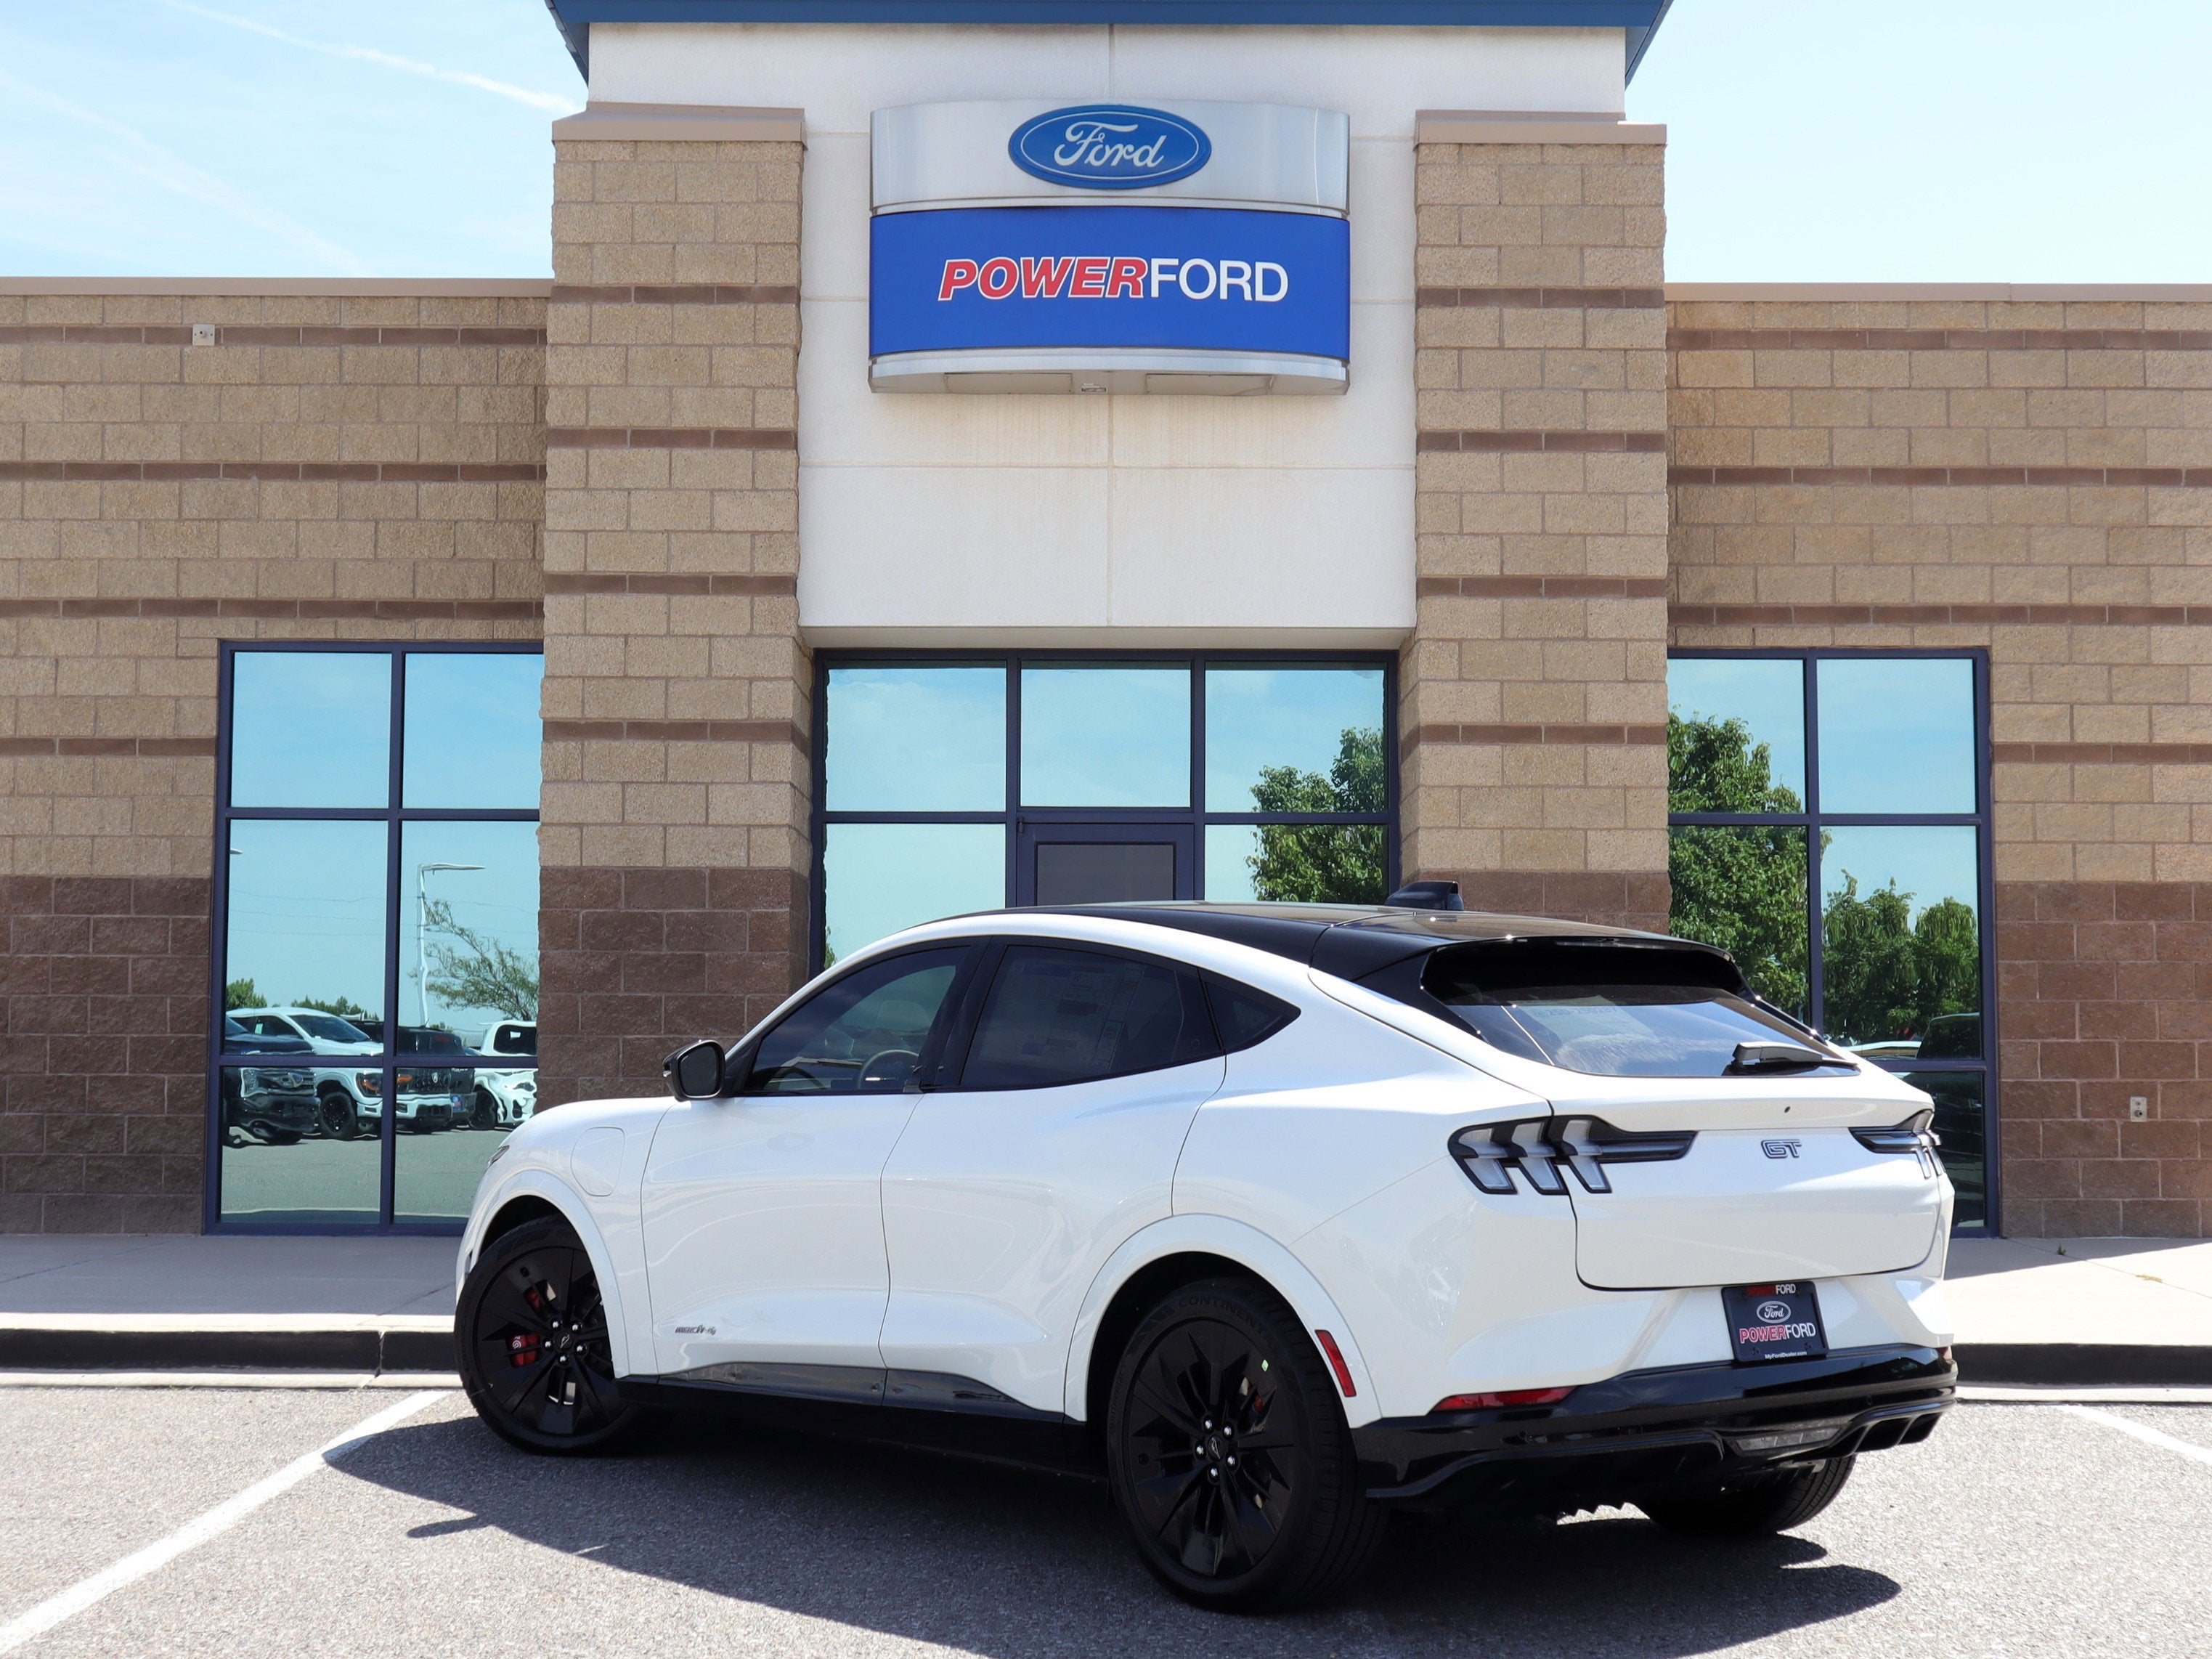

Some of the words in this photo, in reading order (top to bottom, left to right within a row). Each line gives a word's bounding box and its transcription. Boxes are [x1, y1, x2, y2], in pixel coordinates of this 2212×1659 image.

[1054, 121, 1166, 167] Ford
[1761, 1139, 1802, 1159] GT
[1765, 1305, 1784, 1318] Ford
